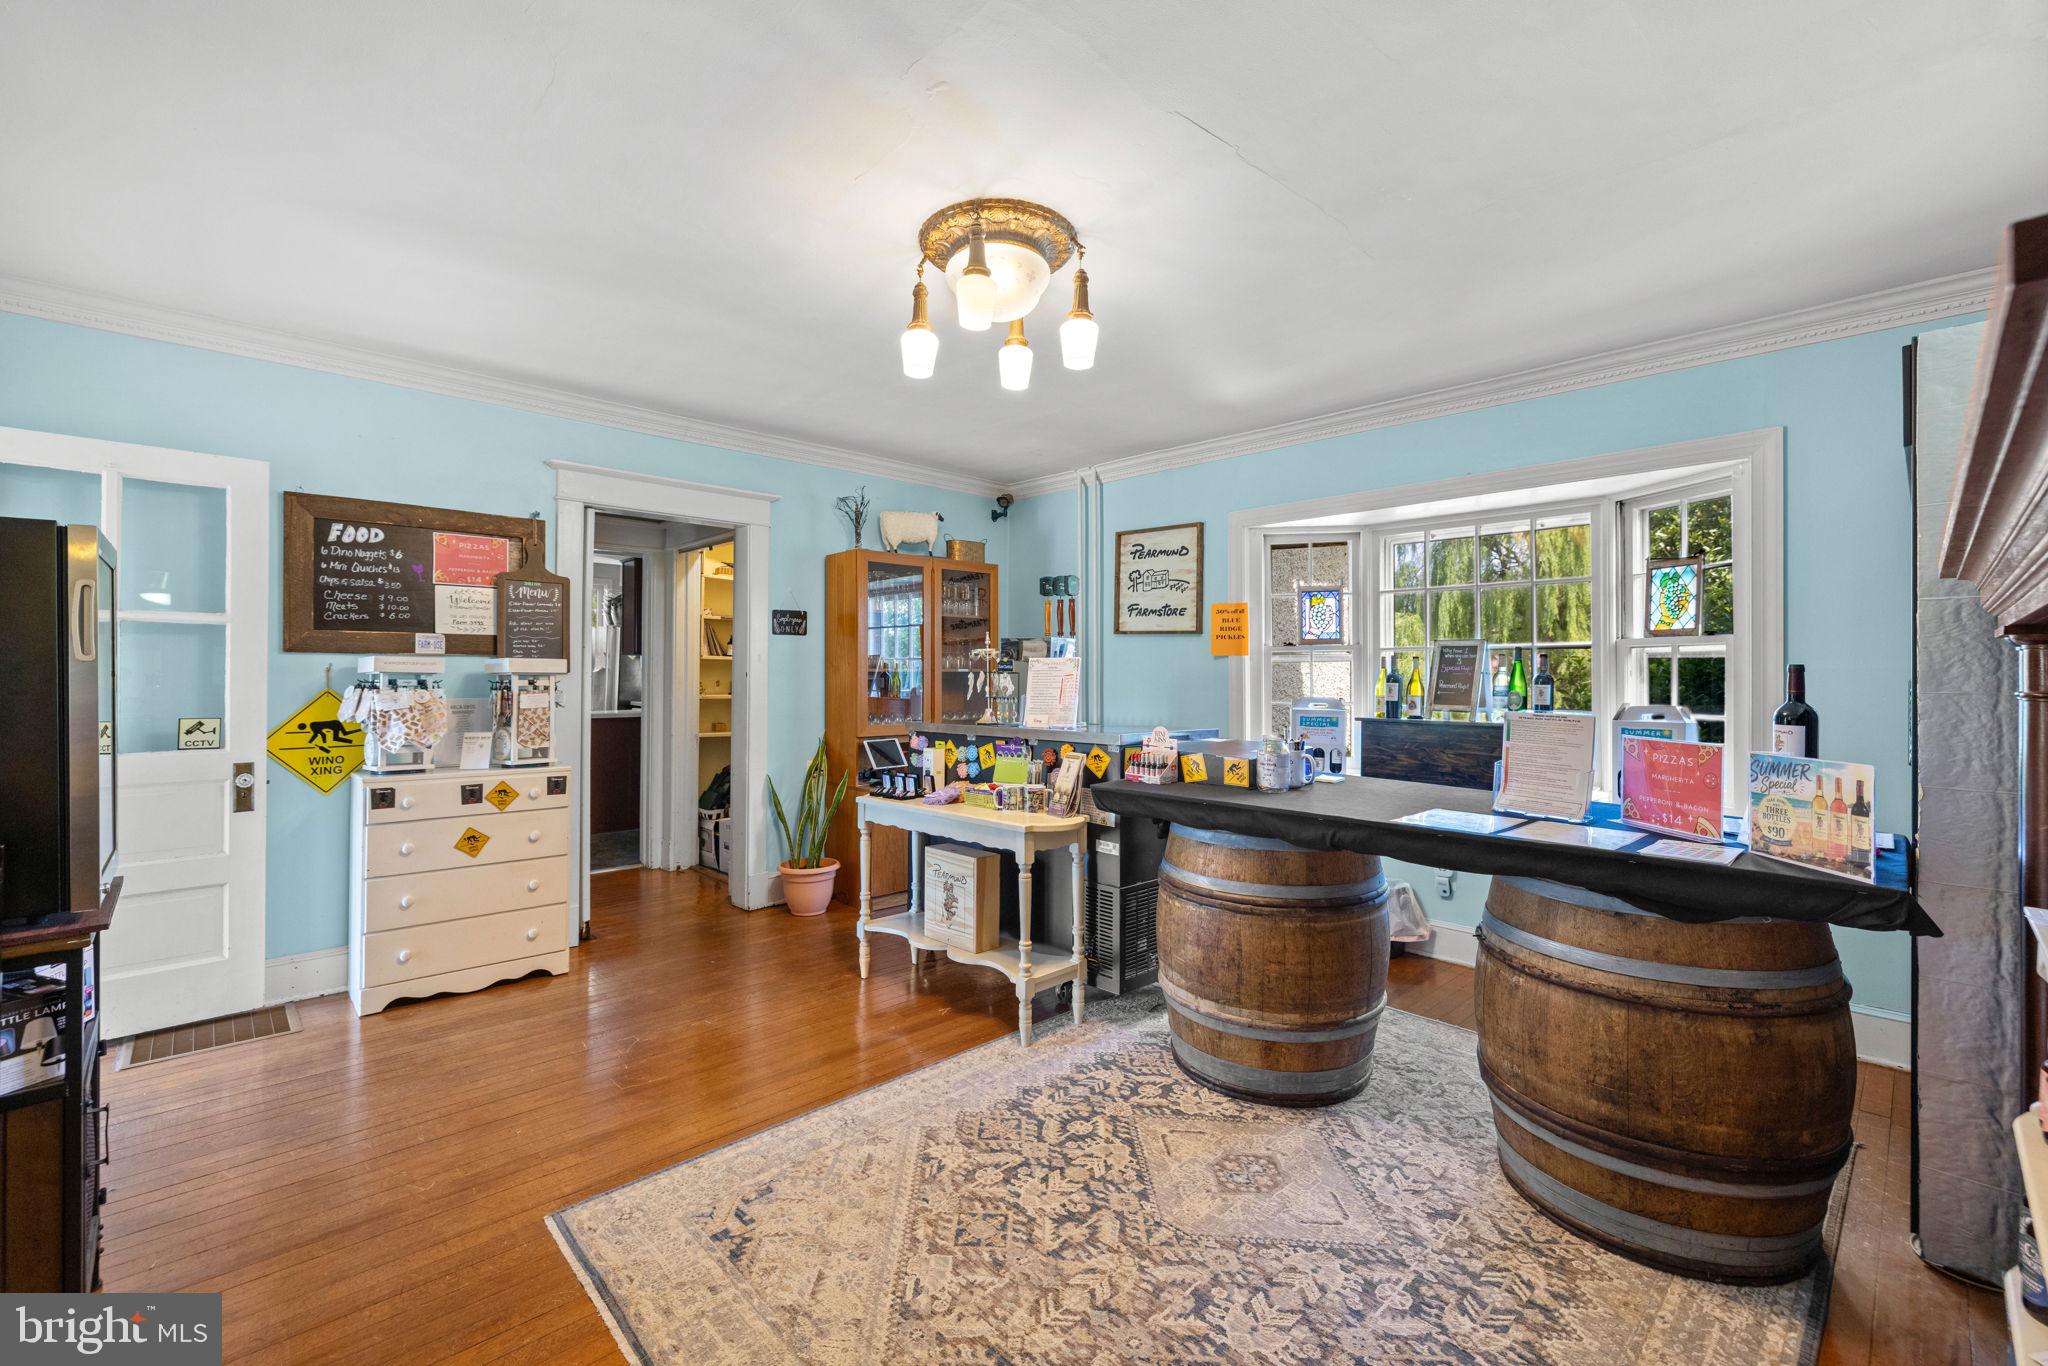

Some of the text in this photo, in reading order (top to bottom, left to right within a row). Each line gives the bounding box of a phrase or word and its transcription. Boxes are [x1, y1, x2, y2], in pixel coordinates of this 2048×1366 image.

[328, 523, 384, 543] FOOD
[331, 546, 353, 557] Dino
[459, 542, 489, 551] PIZZAS
[1130, 543, 1189, 560] PEARMUND
[323, 589, 368, 601] Cheese
[515, 586, 553, 599] Menu
[325, 601, 358, 612] Meats
[1127, 603, 1187, 617] FARMSTORE
[323, 612, 369, 620] Crackers
[781, 625, 799, 633] ONLY
[184, 739, 215, 748] CCTV
[308, 755, 345, 766] WINO
[1652, 752, 1694, 767] PIZZAS
[310, 766, 343, 775] XING
[1750, 759, 1812, 782] SUMMER
[1651, 773, 1695, 785] MARGHERITA
[1760, 776, 1798, 795] Special
[1638, 794, 1672, 807] PEPPERONI
[1683, 802, 1709, 814] BACON
[1765, 805, 1788, 816] THREE
[1662, 813, 1682, 825] $14
[1763, 812, 1791, 824] BOTTLES
[1767, 825, 1785, 839] $90
